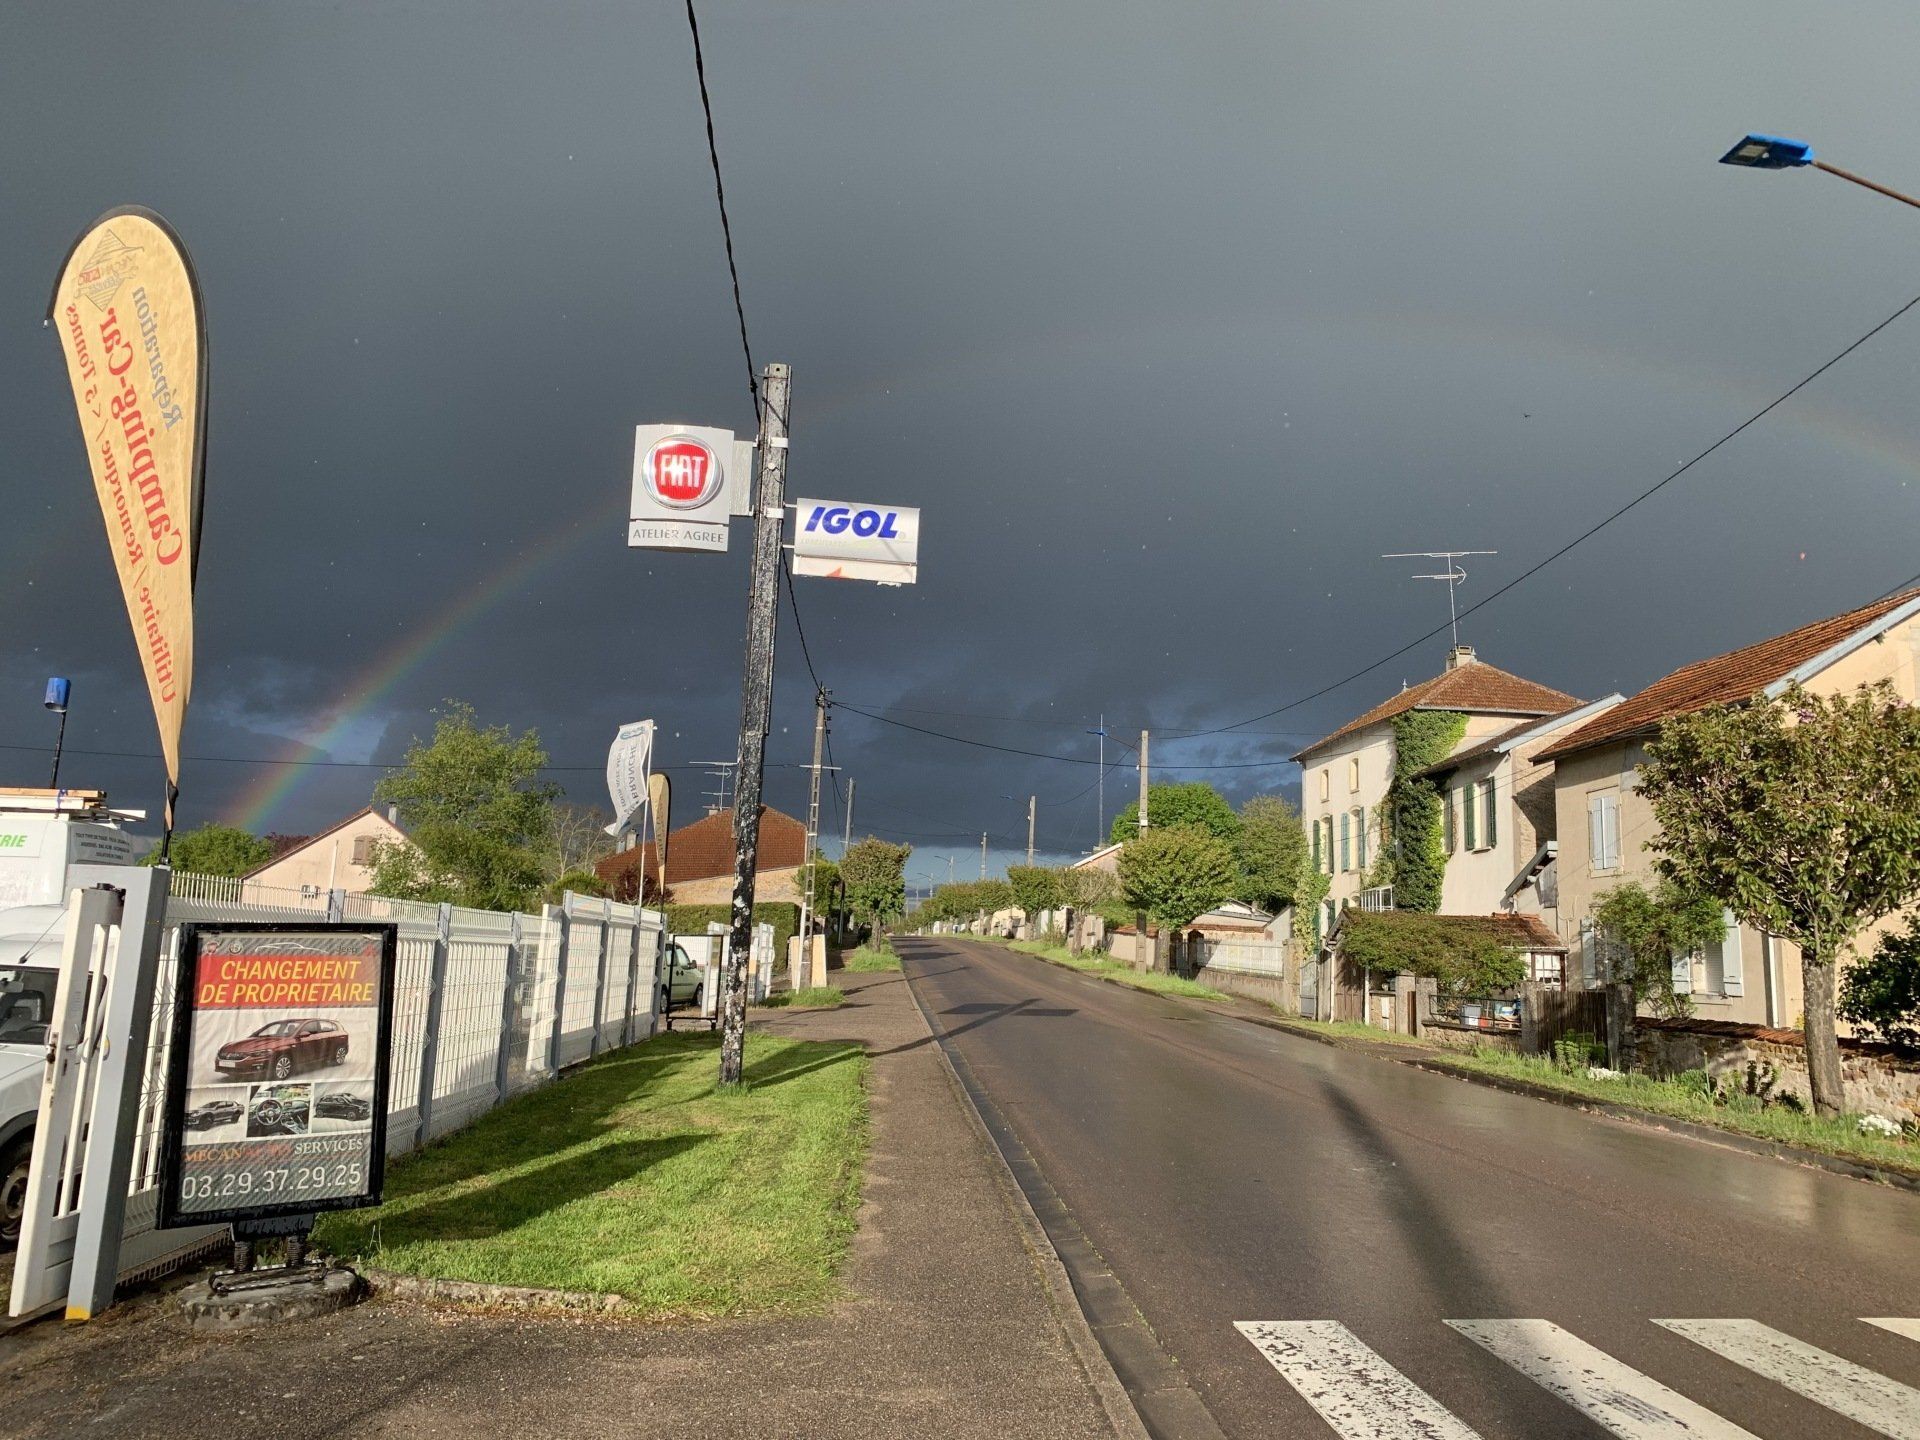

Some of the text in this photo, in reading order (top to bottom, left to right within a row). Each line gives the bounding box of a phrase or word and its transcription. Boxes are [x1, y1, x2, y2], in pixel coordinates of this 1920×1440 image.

[660, 454, 705, 488] FIAT
[805, 506, 899, 539] IGOL
[632, 528, 725, 543] ATELIER AGREE
[0, 834, 28, 848] RIE
[221, 960, 361, 981] CHANGEMENT
[200, 982, 375, 1004] DE PROPRIETAIRE
[293, 1138, 364, 1155] SERVICES
[181, 1162, 361, 1200] 03.29.37.29.25
